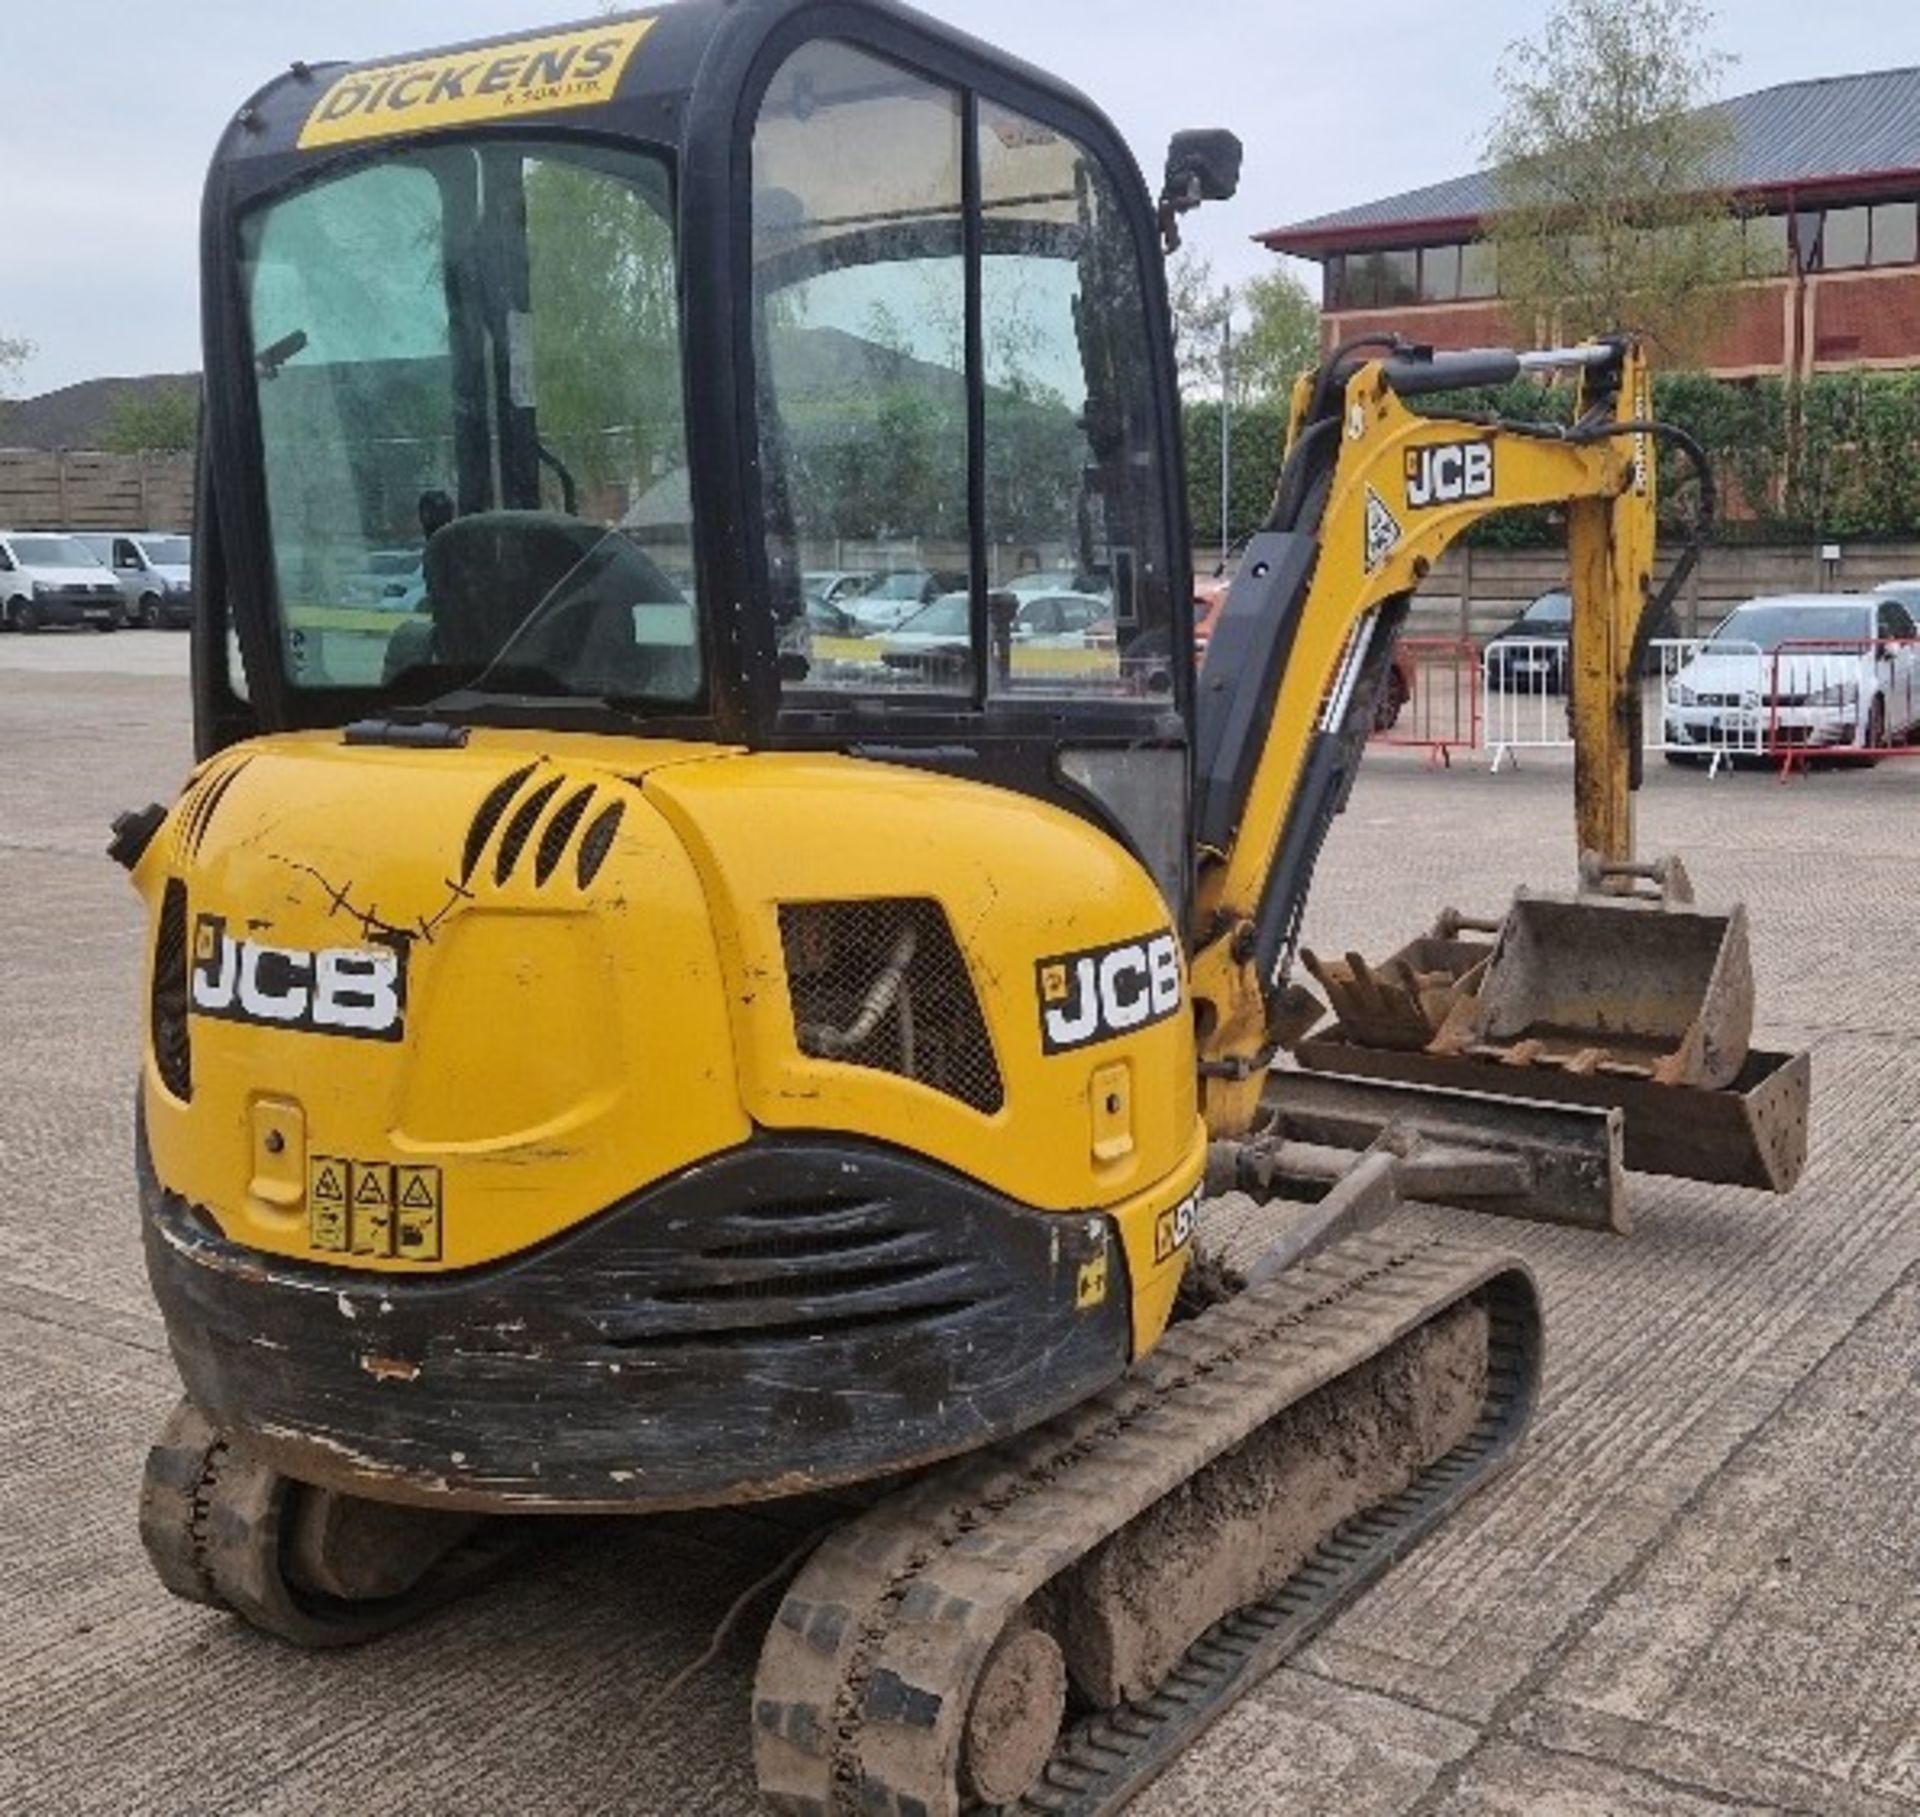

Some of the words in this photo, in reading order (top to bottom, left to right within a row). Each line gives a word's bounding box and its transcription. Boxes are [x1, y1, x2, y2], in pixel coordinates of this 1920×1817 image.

[317, 37, 624, 122] DICKENS
[1407, 443, 1491, 504] JCB
[193, 936, 398, 1030] JCB
[1045, 935, 1178, 1043] JCB
